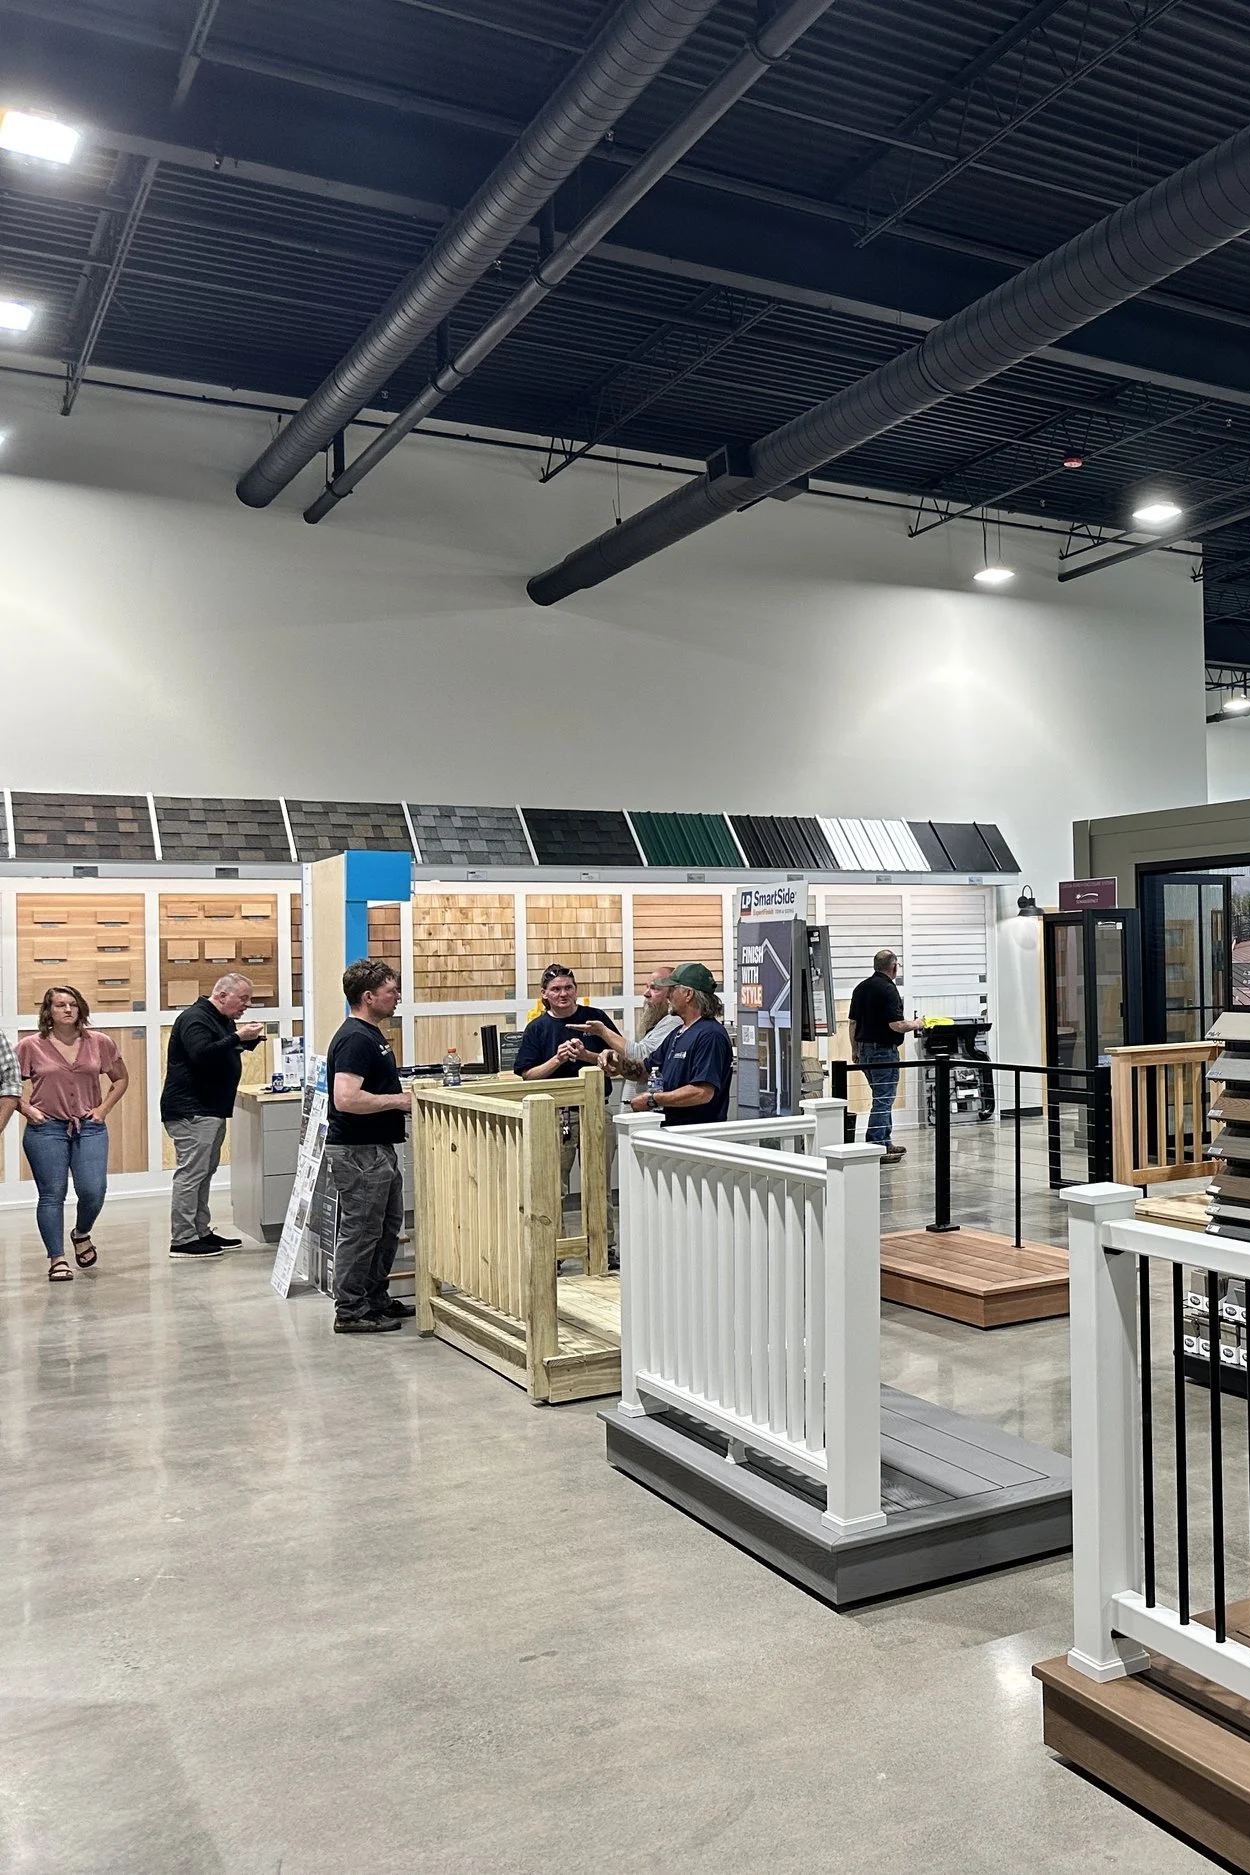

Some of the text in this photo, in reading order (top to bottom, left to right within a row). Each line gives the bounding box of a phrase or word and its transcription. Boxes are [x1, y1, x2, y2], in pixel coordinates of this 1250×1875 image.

[742, 888, 795, 909] LP SmartSide
[742, 946, 763, 964] FINISH
[741, 966, 759, 984] WITH
[741, 986, 763, 1006] STYLE
